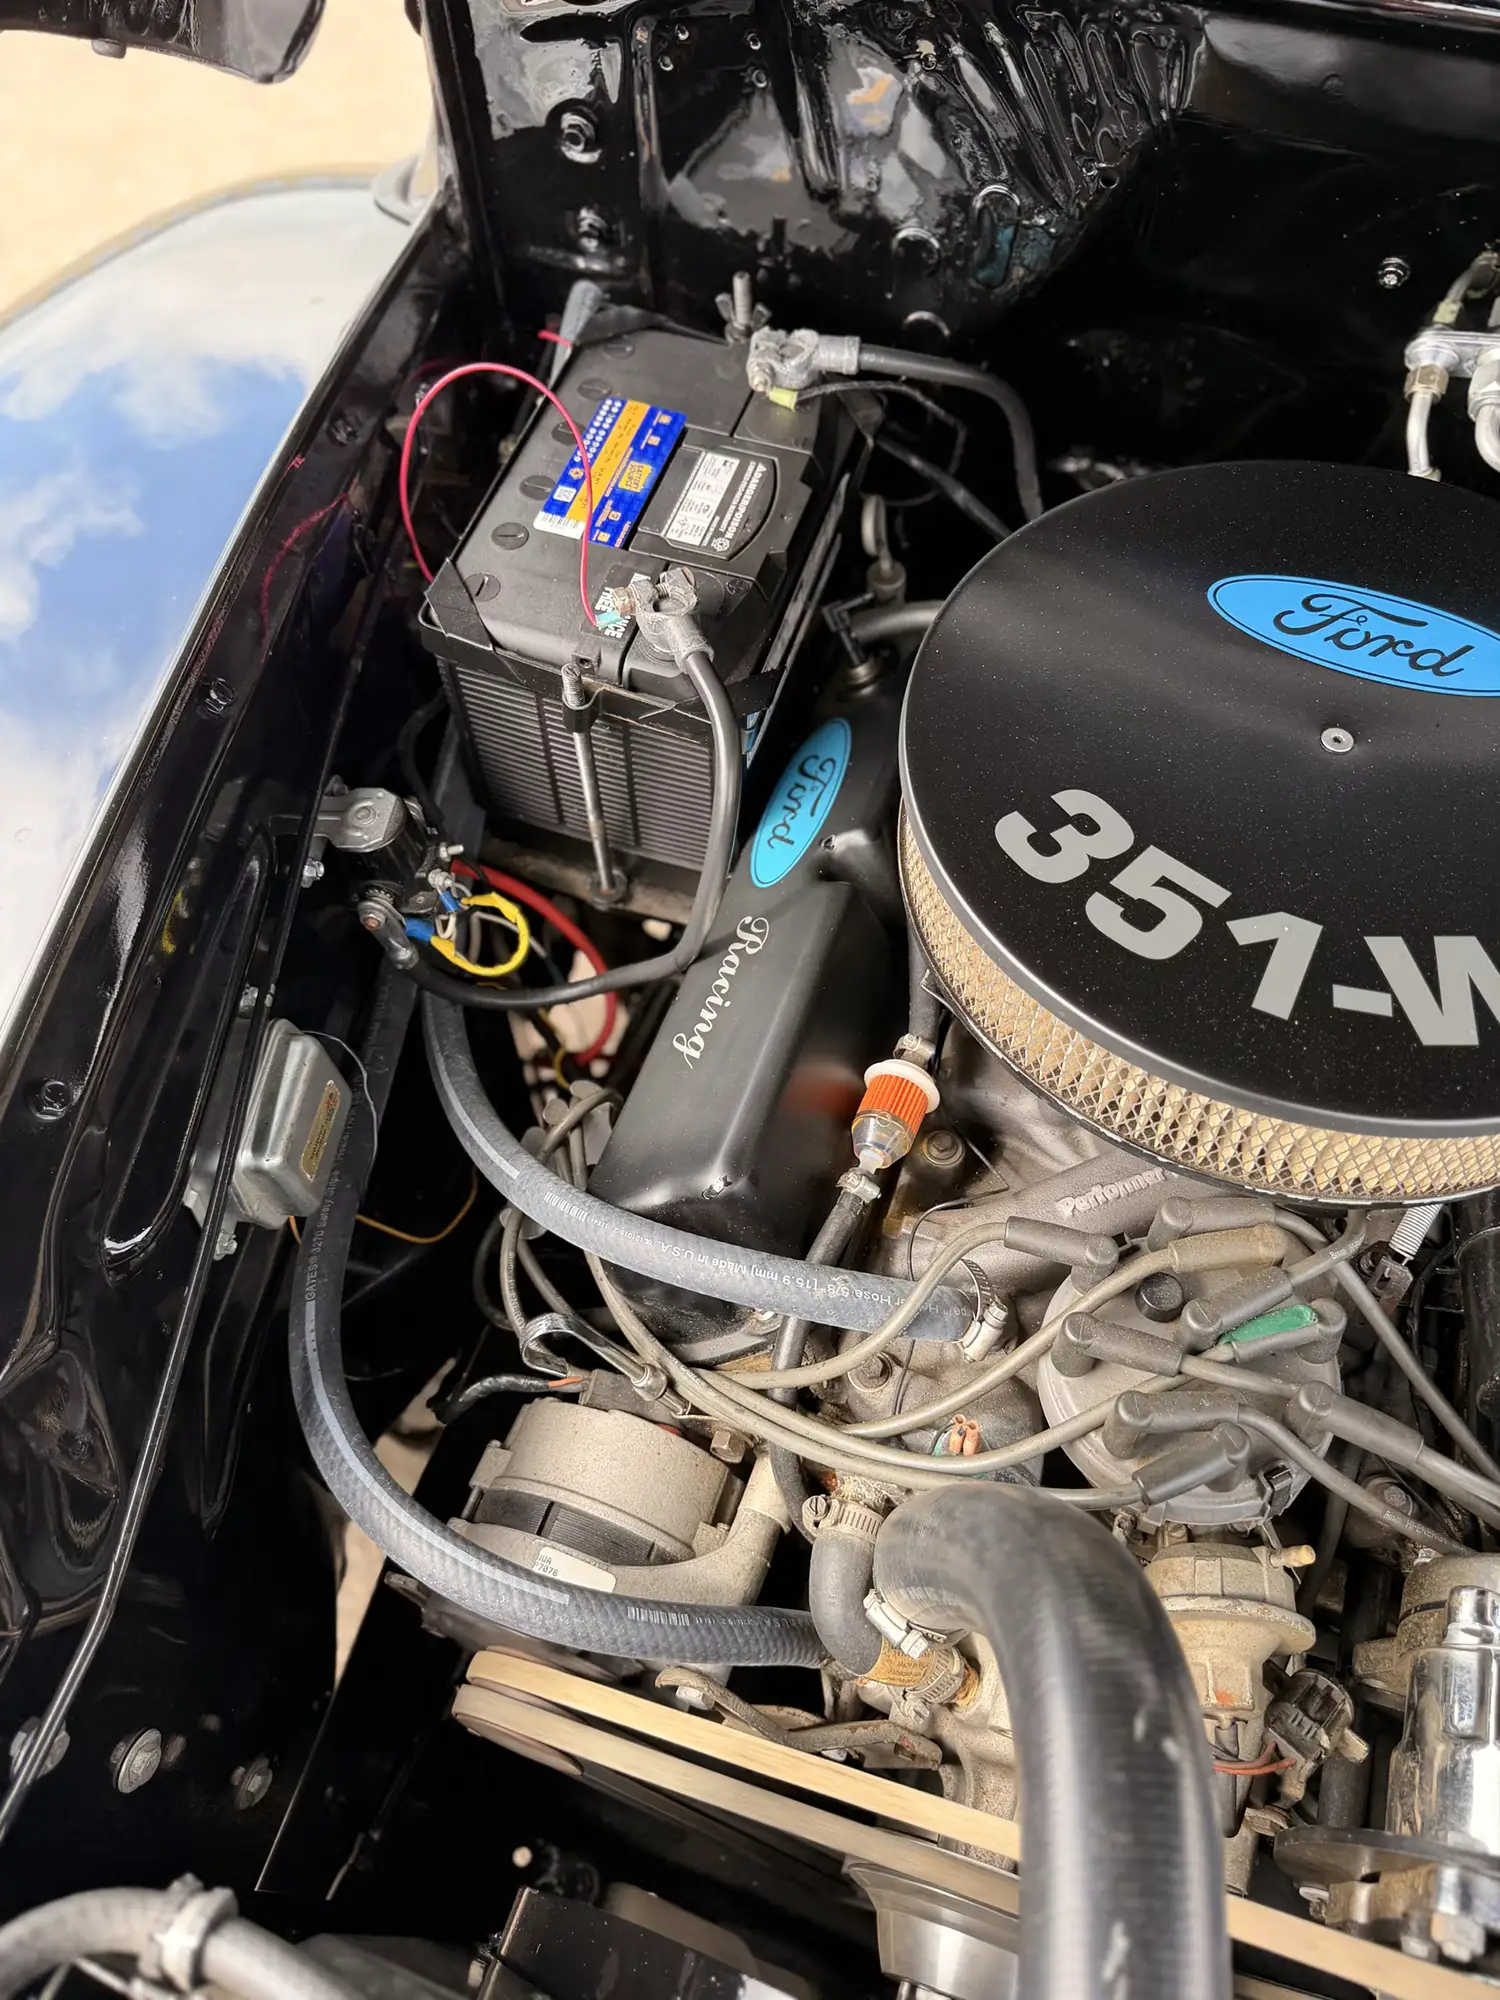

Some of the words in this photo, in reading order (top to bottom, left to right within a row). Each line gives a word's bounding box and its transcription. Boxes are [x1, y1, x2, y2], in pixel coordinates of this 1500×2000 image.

[624, 462, 637, 488] SOURCE
[631, 463, 643, 490] BATTERY
[1273, 592, 1475, 678] Ford
[768, 754, 836, 850] Ford
[672, 916, 770, 1069] Racing
[1056, 1167, 1167, 1220] Performer
[312, 1229, 325, 1253] 3270
[655, 1240, 695, 1261] U.S.A.
[695, 1251, 709, 1265] In
[709, 1255, 748, 1276] Made
[853, 1287, 890, 1304] Hose
